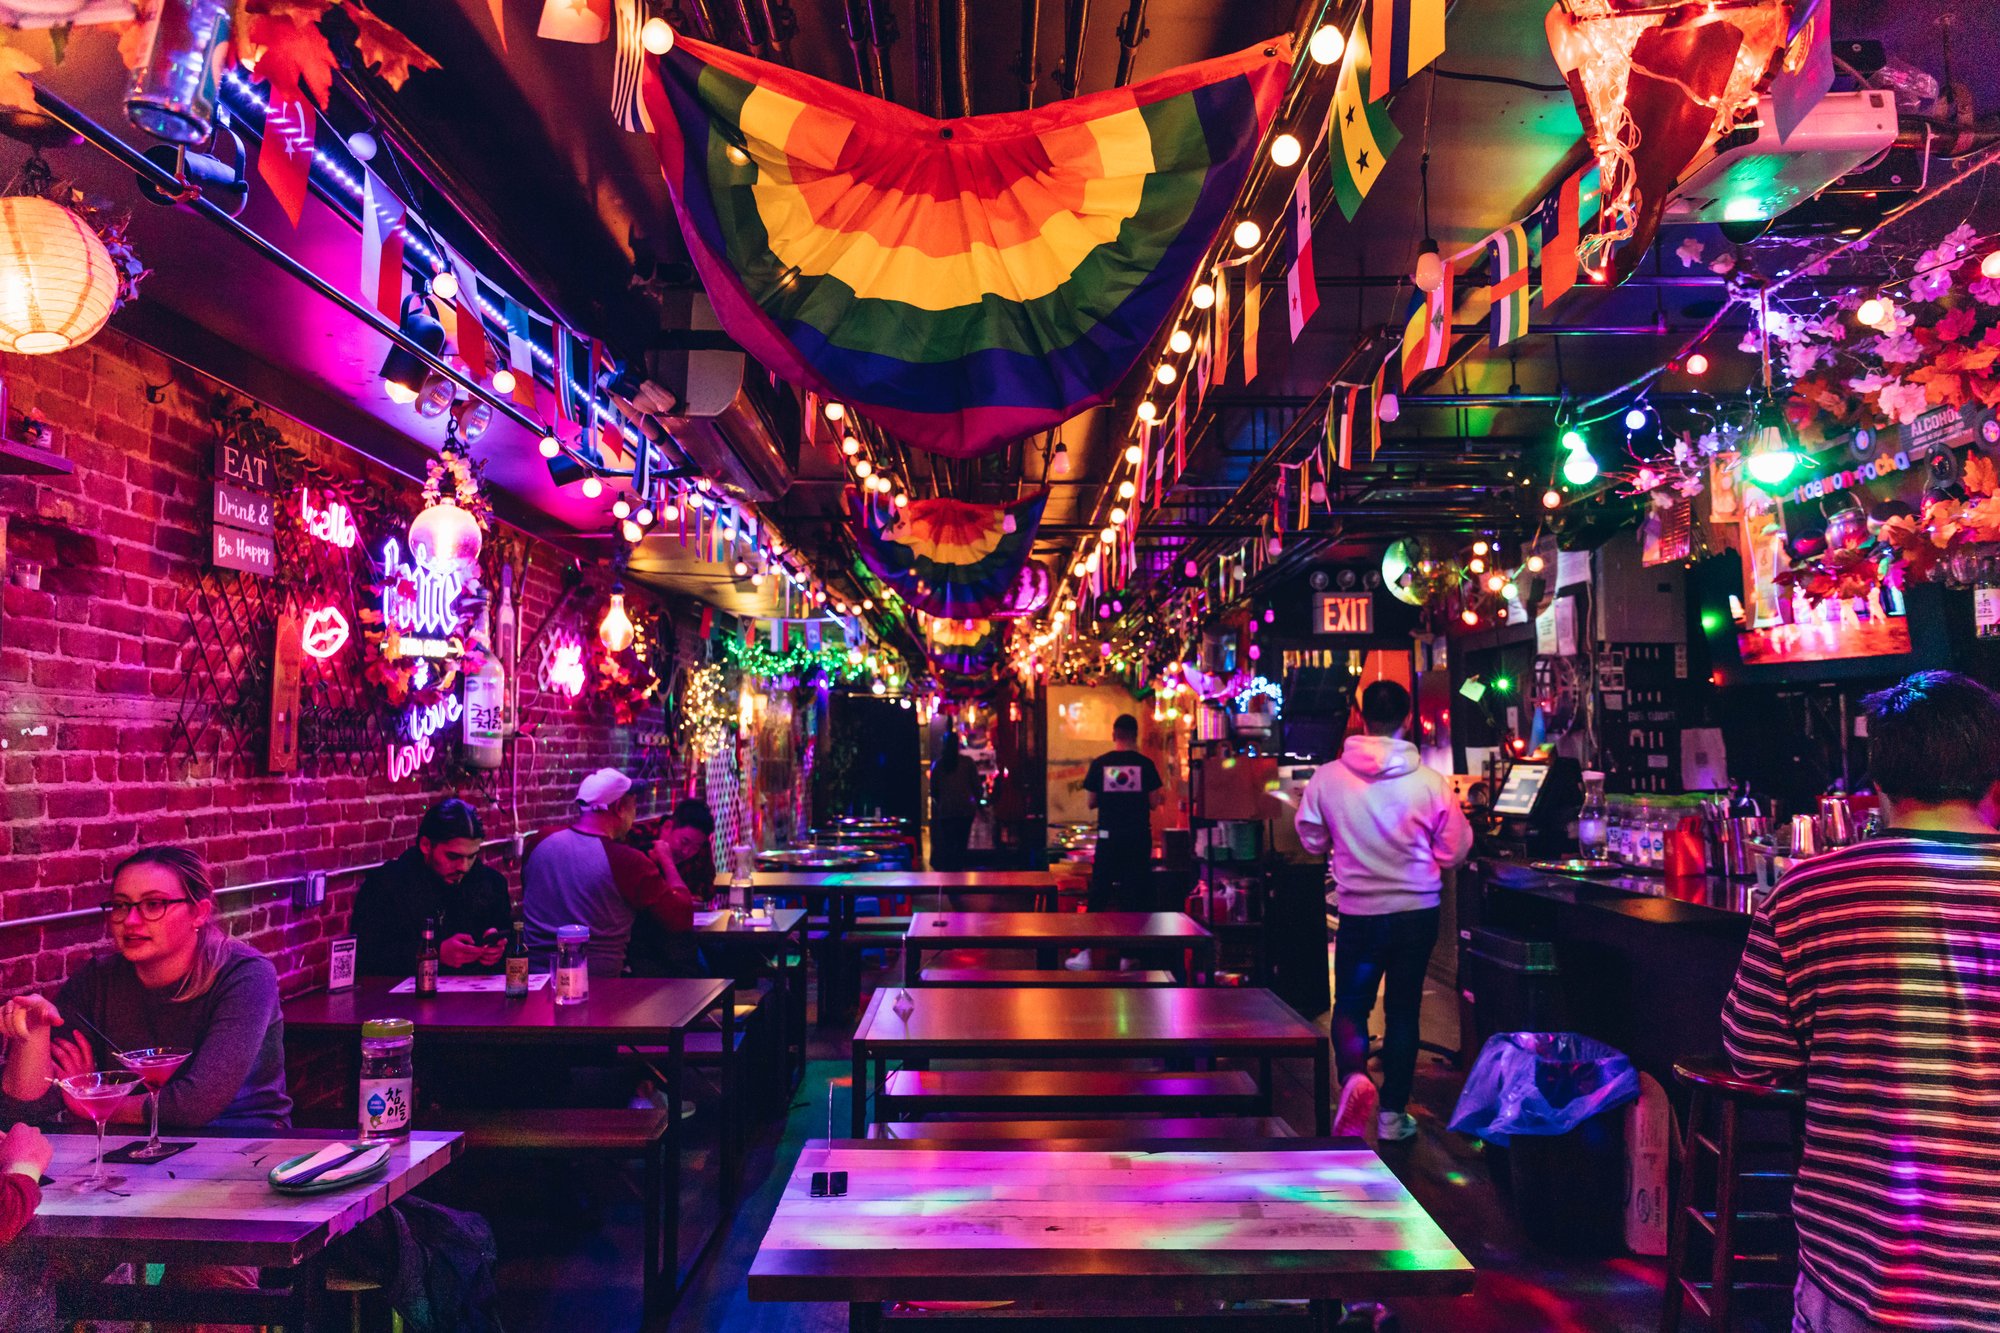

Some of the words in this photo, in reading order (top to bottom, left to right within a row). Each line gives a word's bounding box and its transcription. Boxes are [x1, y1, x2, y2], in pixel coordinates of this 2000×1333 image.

[223, 445, 268, 486] EAT
[218, 490, 257, 524] Drink
[258, 504, 269, 526] &
[302, 487, 355, 548] hello
[218, 533, 235, 559] Be
[236, 537, 271, 566] Happy
[1323, 598, 1369, 631] EXIT
[388, 736, 435, 782] love
